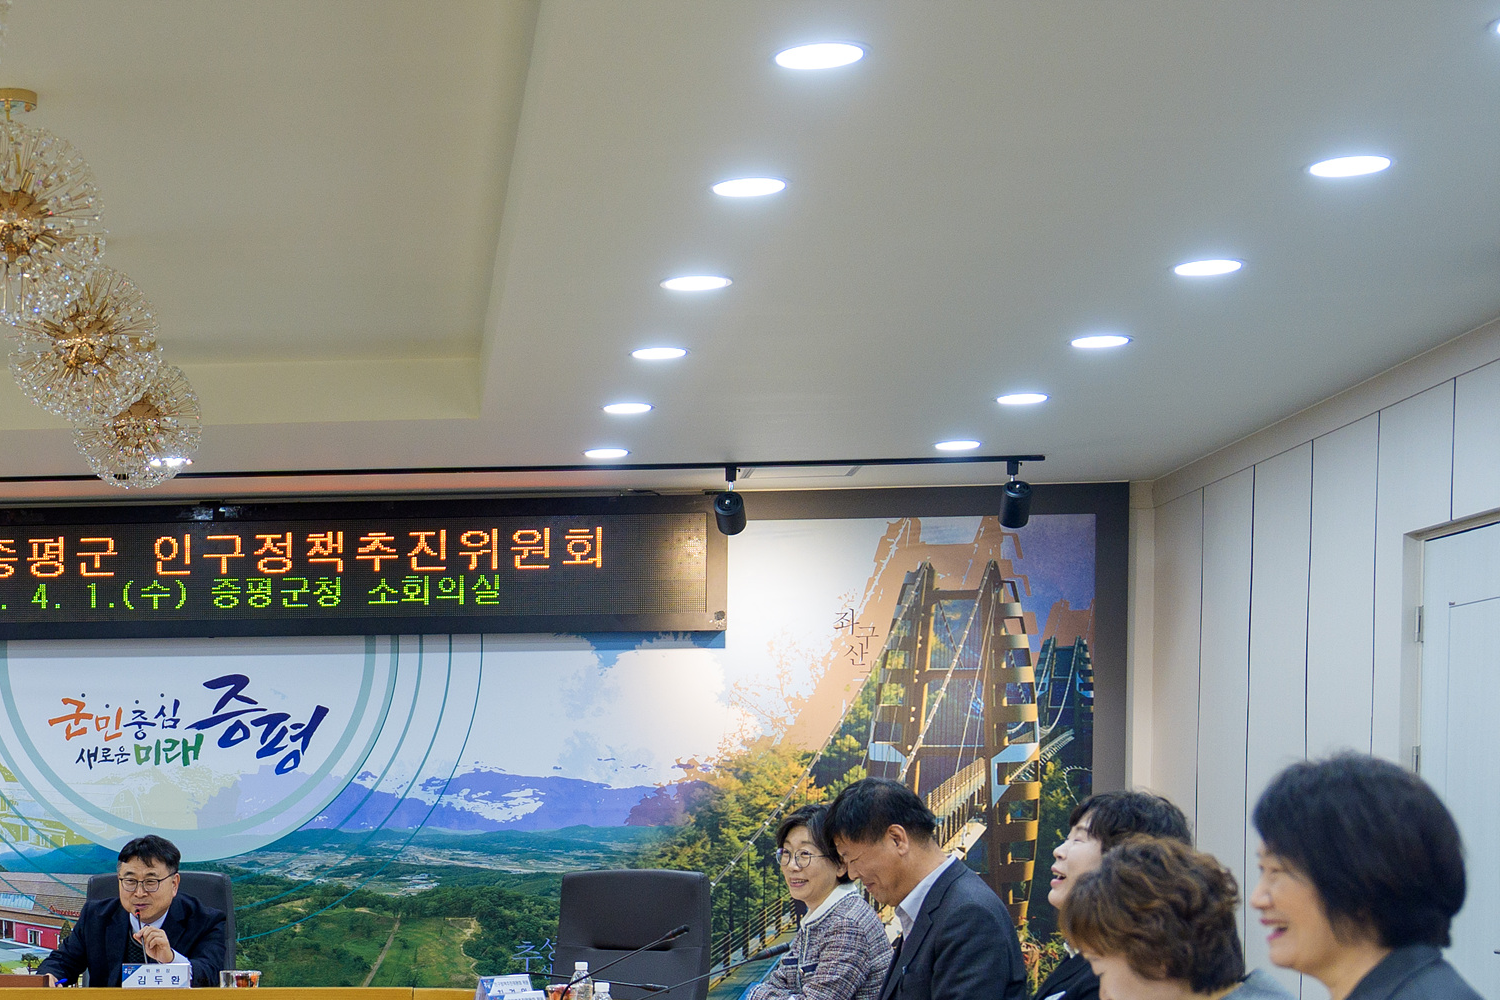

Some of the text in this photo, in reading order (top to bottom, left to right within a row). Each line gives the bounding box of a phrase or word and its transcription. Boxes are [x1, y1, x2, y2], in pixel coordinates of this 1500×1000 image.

[153, 526, 603, 576] 인구정책추진위원회
[211, 576, 342, 609] 증평군청
[368, 574, 500, 606] 소회의실
[833, 608, 879, 666] 좌구산
[48, 694, 181, 742] 군민중심
[185, 673, 329, 775] 증평
[75, 733, 205, 770] 새로운 미래
[137, 975, 181, 986] 김두환
